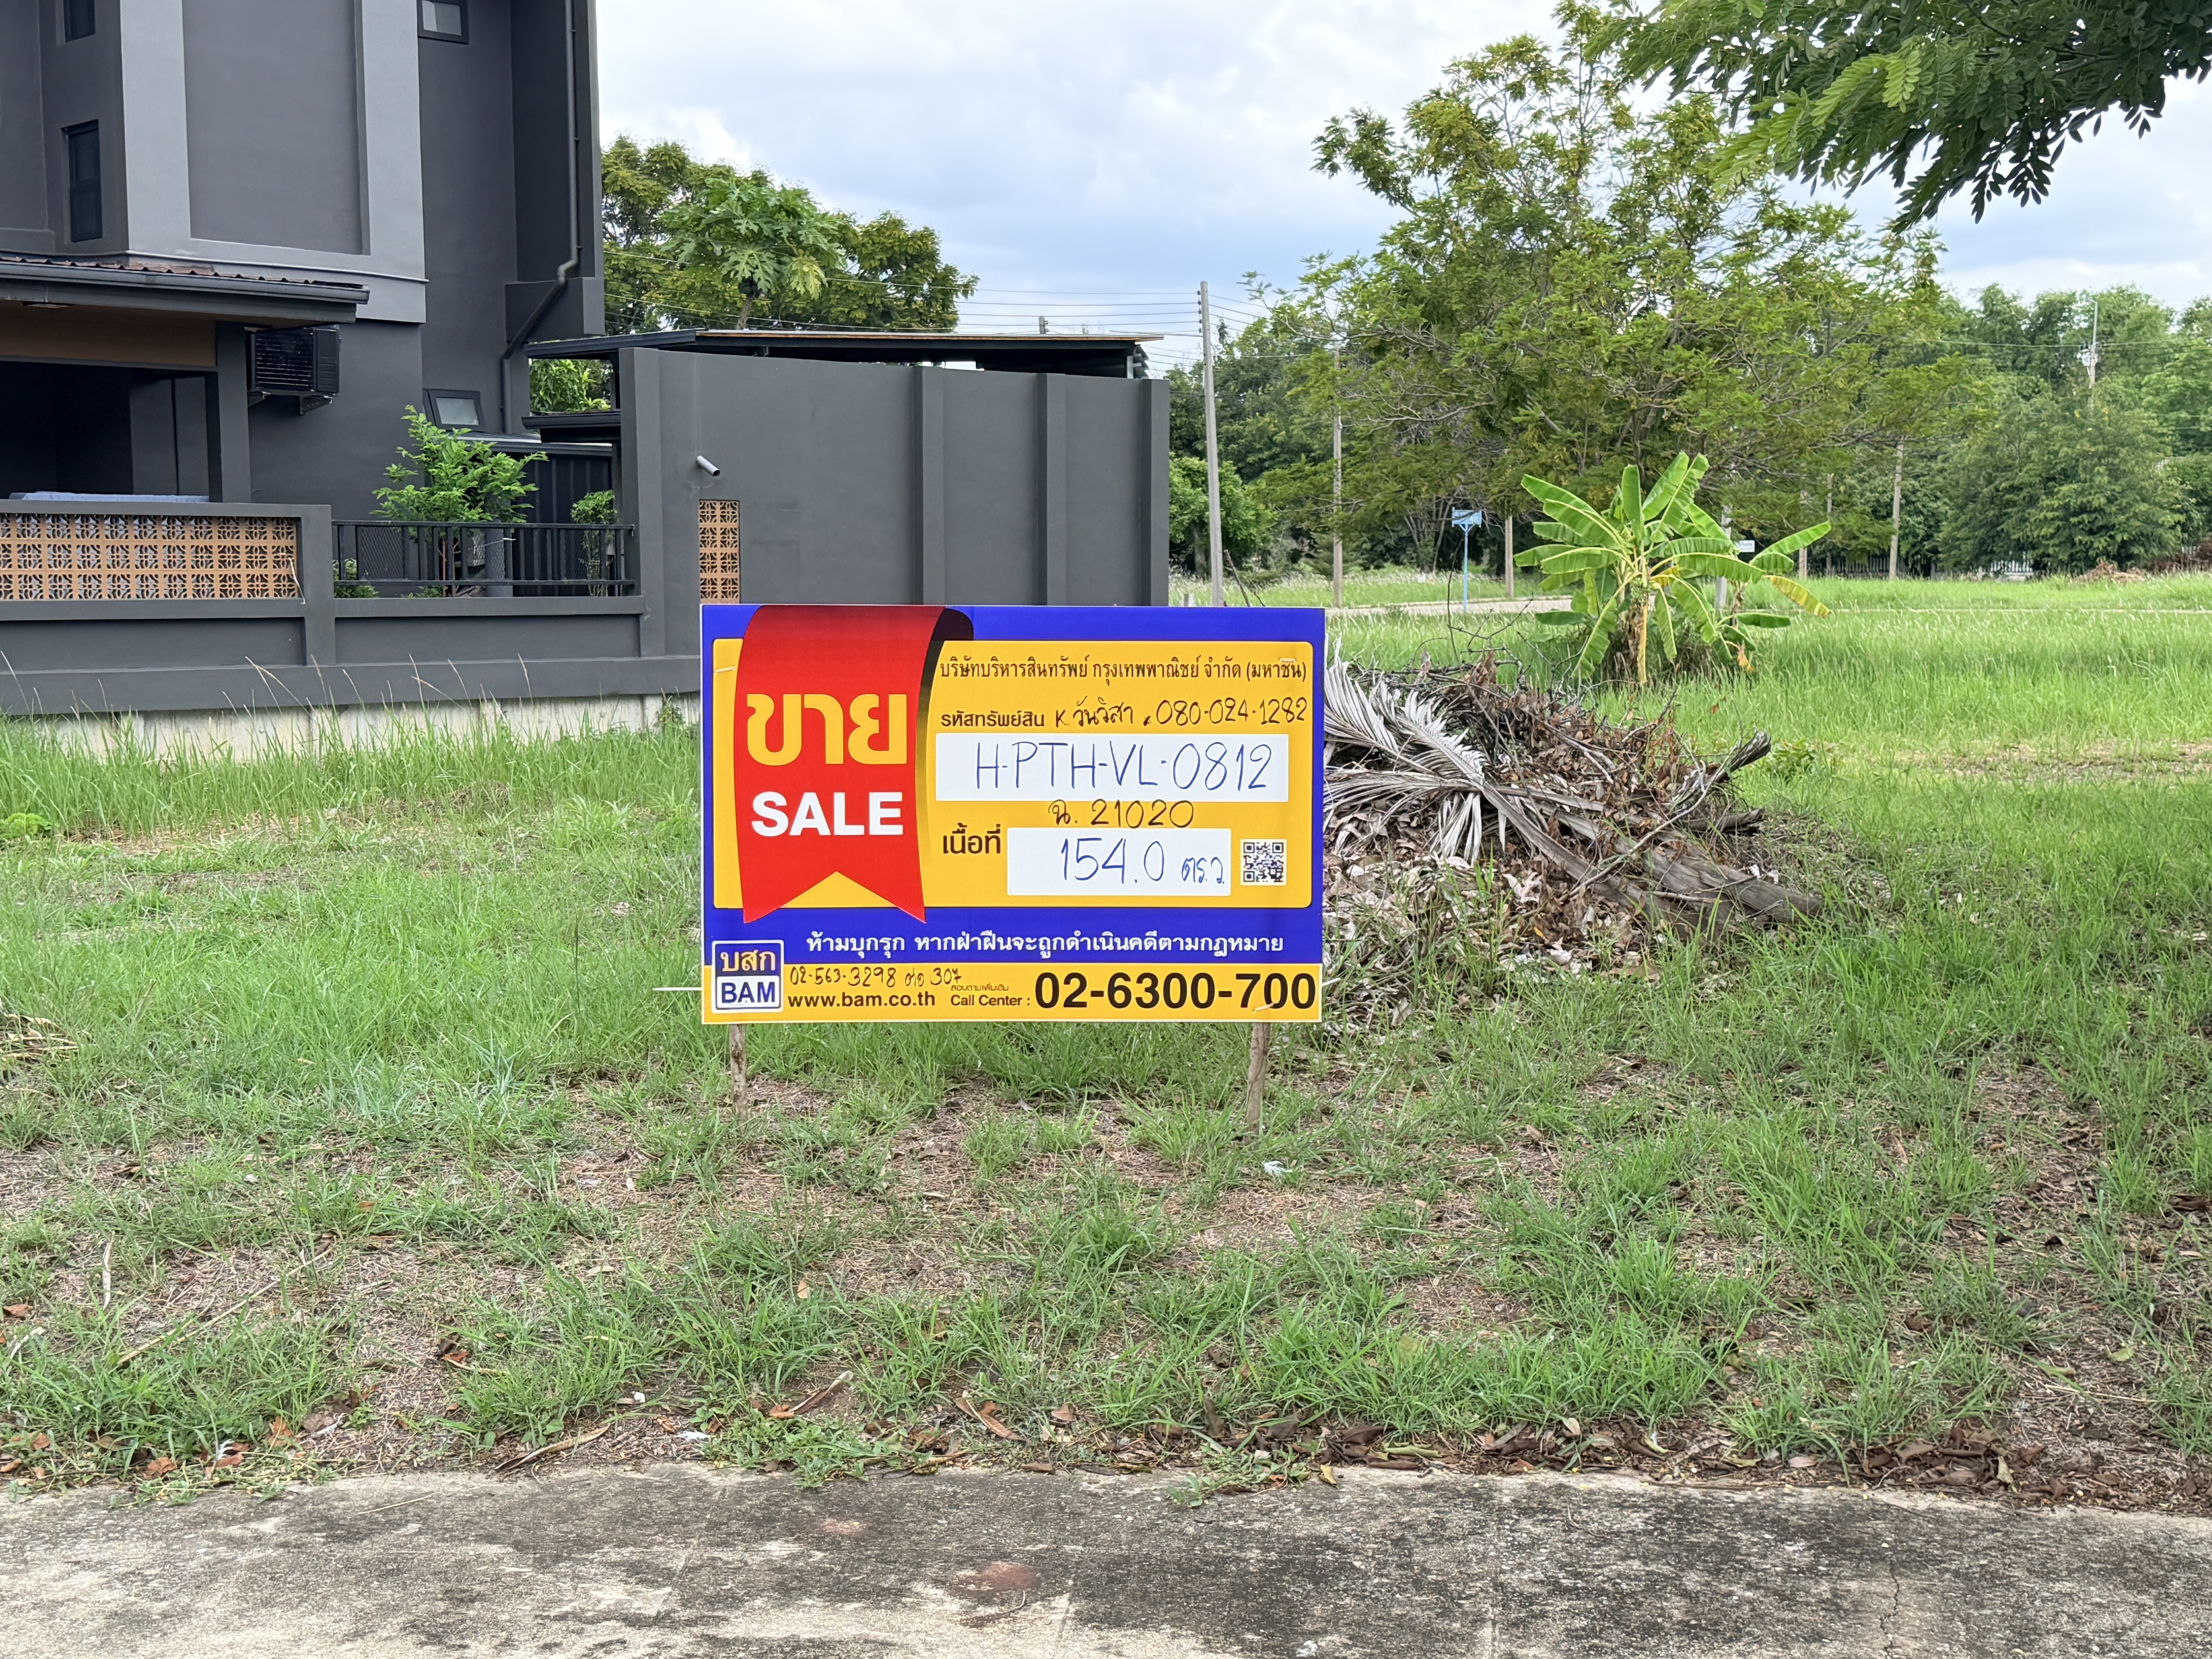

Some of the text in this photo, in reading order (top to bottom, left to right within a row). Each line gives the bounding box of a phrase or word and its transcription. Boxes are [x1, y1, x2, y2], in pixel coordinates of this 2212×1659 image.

[940, 654, 1307, 686] บริษัทบริหารสินทรัพย์ กรุงเทพพาณิชย์ จำกัด (มหาชน)
[747, 694, 907, 766] ขาย
[941, 710, 1045, 727] รหัสทรัพย์สิน
[752, 791, 903, 837] SALE
[1091, 798, 1194, 829] 21020
[942, 822, 1001, 855] เนื้อที่
[1060, 836, 1165, 885] 154.0
[806, 929, 1284, 959] ห้ามบุกรุก หากฝ่าฝืนจะถูกดำเนินคดีตามกฎหมาย
[720, 950, 776, 972] บสก
[721, 982, 775, 1003] BAM
[788, 991, 936, 1007] www.bam.co.th
[951, 994, 975, 1006] Call
[979, 994, 1023, 1006] Center
[1035, 972, 1316, 1009] 02-6300-700
